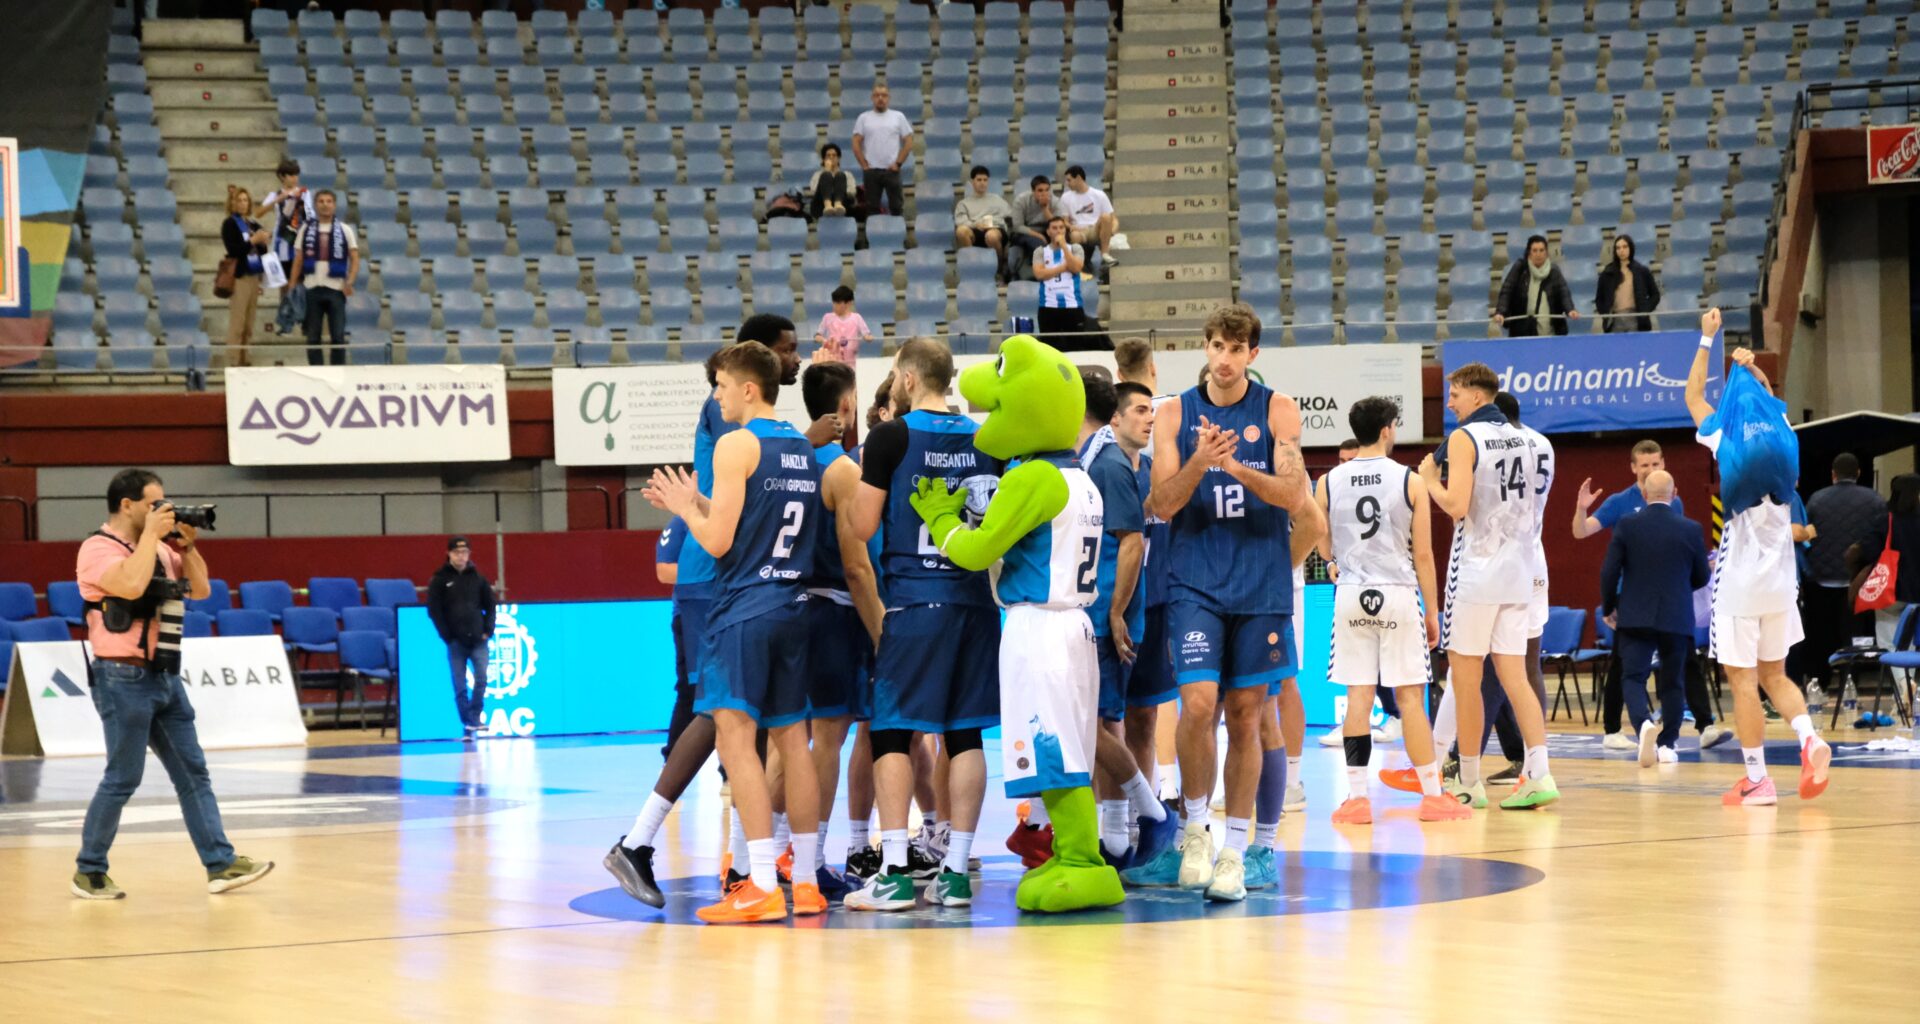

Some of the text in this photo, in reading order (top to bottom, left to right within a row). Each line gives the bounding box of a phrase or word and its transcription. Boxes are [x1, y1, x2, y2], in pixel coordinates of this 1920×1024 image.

[1182, 46, 1201, 54] FILA
[1184, 106, 1203, 114] FILA
[1185, 136, 1204, 144] FILA
[1184, 166, 1204, 175] FILA
[1184, 199, 1204, 207] FILA
[1183, 233, 1204, 241] FILA
[1185, 303, 1206, 312] FILA
[356, 382, 493, 391] DONOSTIA SAN SEBASTIAN
[1535, 393, 1629, 407] INTEGRAL
[1643, 391, 1677, 402] DEL
[781, 453, 809, 470] HANZLIK
[925, 451, 976, 468] KORSANTIA
[1351, 473, 1382, 487] PERIS
[1495, 456, 1526, 502] 14
[1213, 484, 1245, 518] 12
[1355, 495, 1381, 540] 9
[772, 501, 804, 558] 2
[1077, 536, 1098, 593] 2
